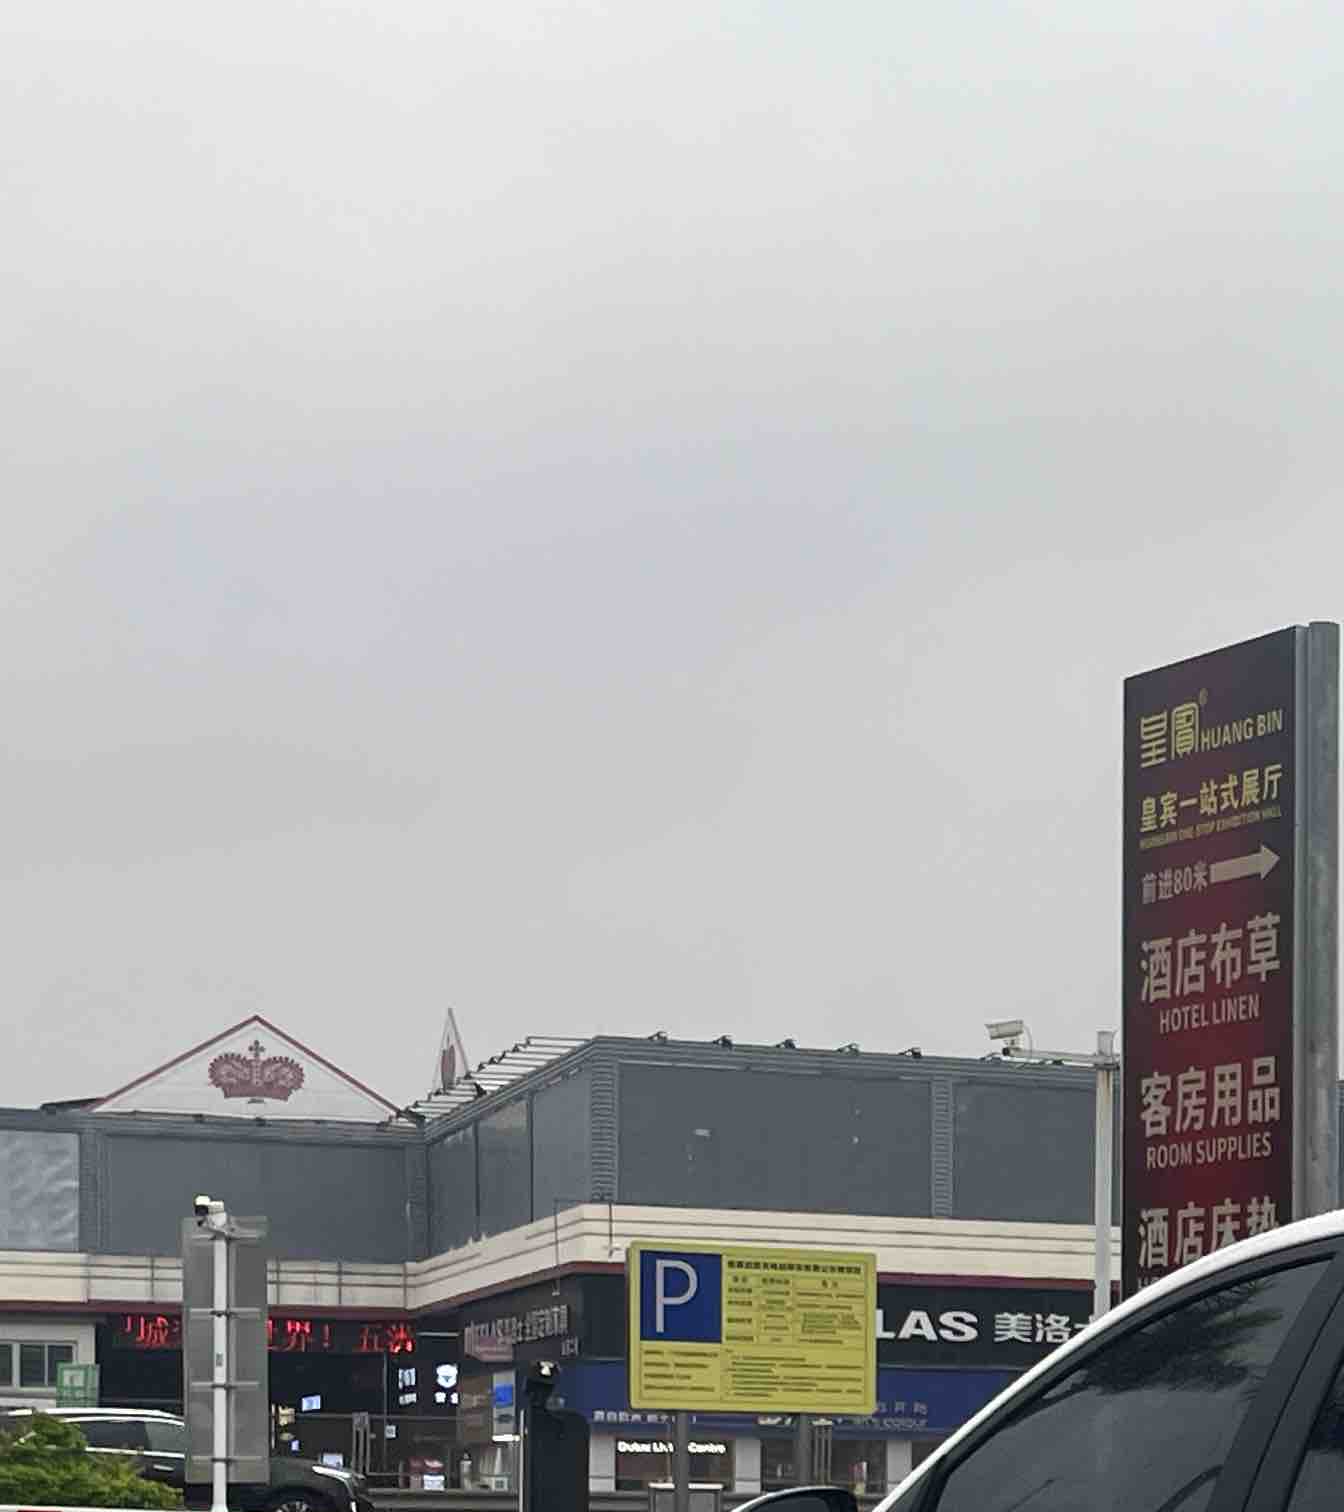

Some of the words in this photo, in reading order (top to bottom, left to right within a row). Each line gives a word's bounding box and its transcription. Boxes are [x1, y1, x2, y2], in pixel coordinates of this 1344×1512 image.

[1200, 719, 1254, 751] HUANG
[1256, 709, 1284, 737] BIN
[1139, 763, 1283, 833] 皇宾一站式展厅
[1140, 911, 1281, 1001] 酒店布草
[1159, 1004, 1210, 1035] HOTEL
[1211, 993, 1260, 1025] LINEN
[1140, 1055, 1281, 1137] 客房用品
[1147, 1140, 1193, 1169] ROOM
[1195, 1131, 1272, 1164] SUPPLIES
[655, 1258, 699, 1334] P
